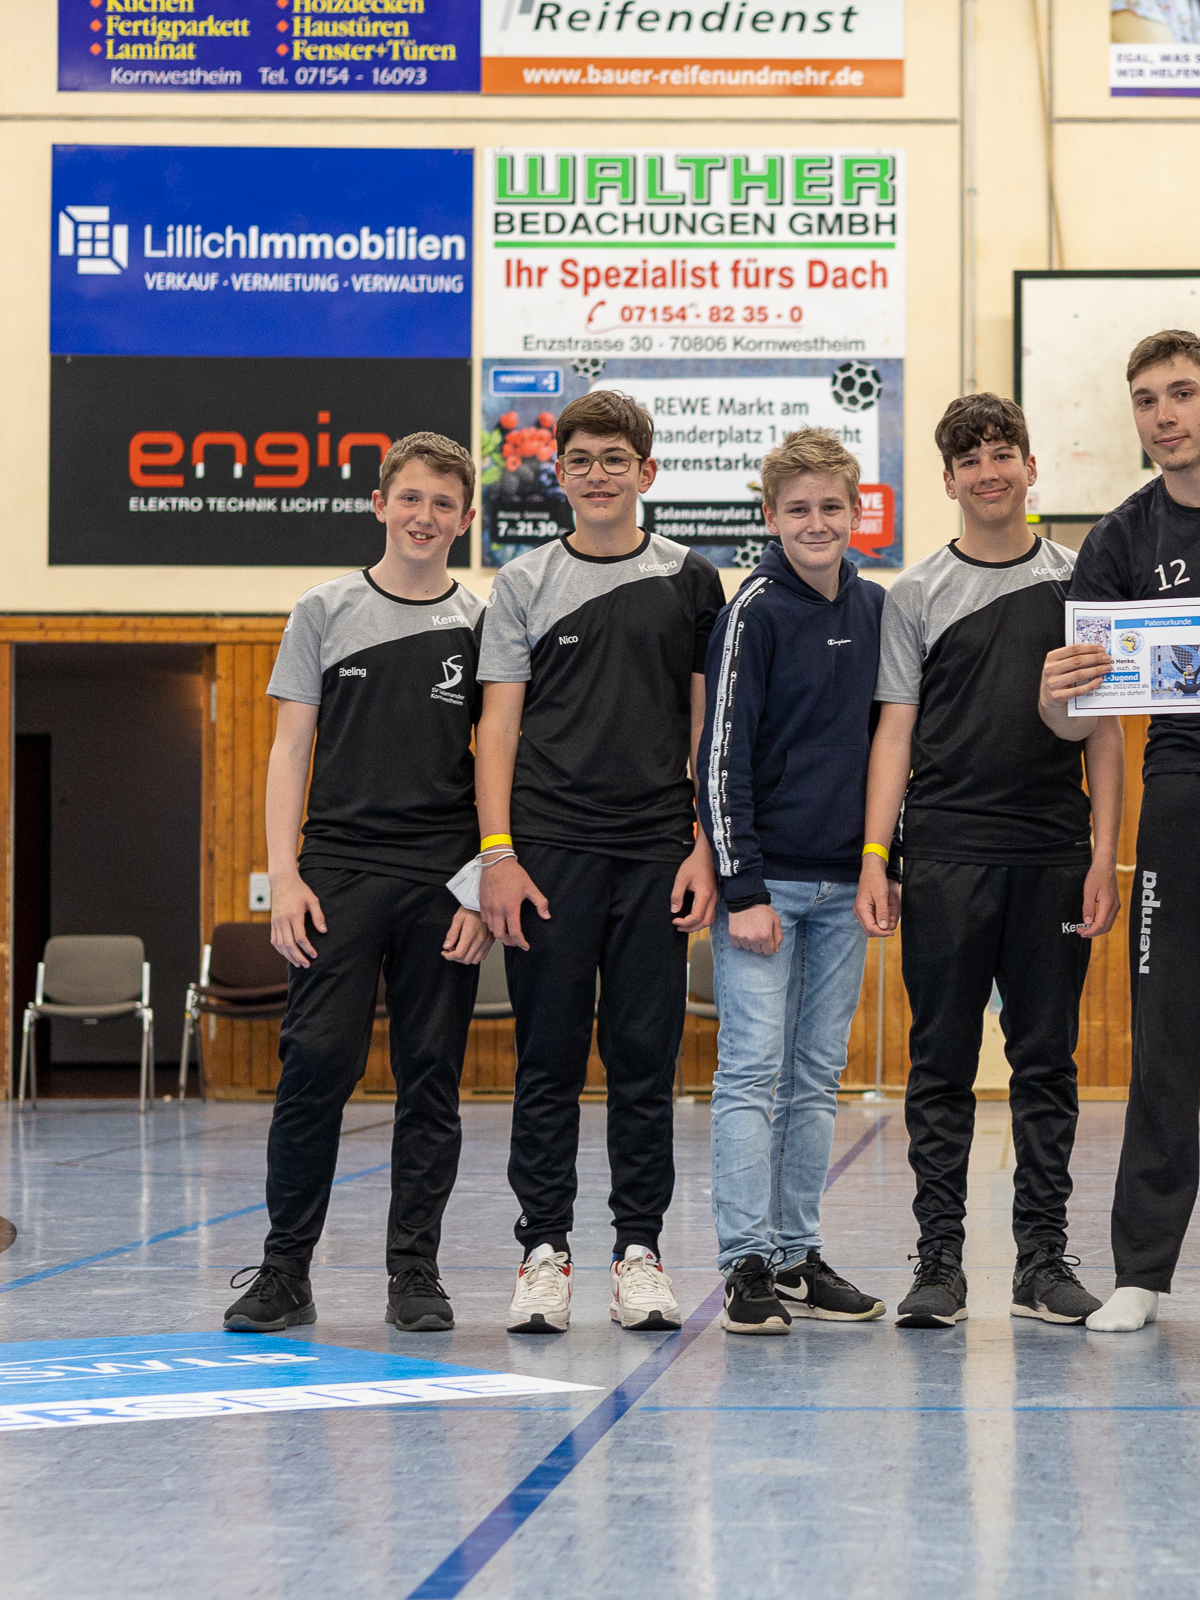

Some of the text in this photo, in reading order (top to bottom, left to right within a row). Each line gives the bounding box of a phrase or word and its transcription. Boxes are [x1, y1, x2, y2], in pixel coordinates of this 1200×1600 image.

[292, 15, 409, 37] Haustüren
[534, 0, 860, 33] Reifendienst
[105, 14, 251, 42] Fertigparkett
[105, 38, 197, 60] Laminat
[292, 39, 457, 61] Fenster+Türen
[1116, 53, 1154, 64] EGAL,
[1159, 53, 1190, 63] WAS
[110, 67, 242, 85] Kornwestheim
[258, 67, 289, 85] Tel.
[295, 67, 349, 85] 07154
[372, 67, 427, 85] 16093
[523, 65, 864, 86] www.bauer-reifenundmehr.de
[1116, 68, 1145, 79] WIR
[1150, 68, 1200, 79] HELFEN
[494, 154, 896, 205] WALTHER
[494, 212, 896, 236] BEDACHUNGEN GMBH
[144, 224, 467, 261] LillichImmobilien
[144, 272, 464, 293] VERKAUF VERMIETUNG VERWALTUNG
[505, 258, 889, 296] Ihr Spezialist fürs Dach
[620, 306, 687, 323] 07154
[709, 306, 735, 323] 82
[743, 306, 769, 323] 35
[523, 335, 866, 353] Enzstrasse 30 70806 Kornwestheim
[654, 398, 710, 415] REWE
[717, 398, 775, 415] Markt
[781, 401, 809, 415] am
[128, 497, 377, 513] ELEKTRO TECHNIK LICHT DESI
[654, 507, 752, 521] Salamanderplatz
[638, 559, 678, 574] Kempa
[1154, 558, 1190, 592] 12
[1144, 619, 1192, 627] Patenurkunde
[558, 634, 579, 645] Nico
[1138, 870, 1162, 974] Kempa
